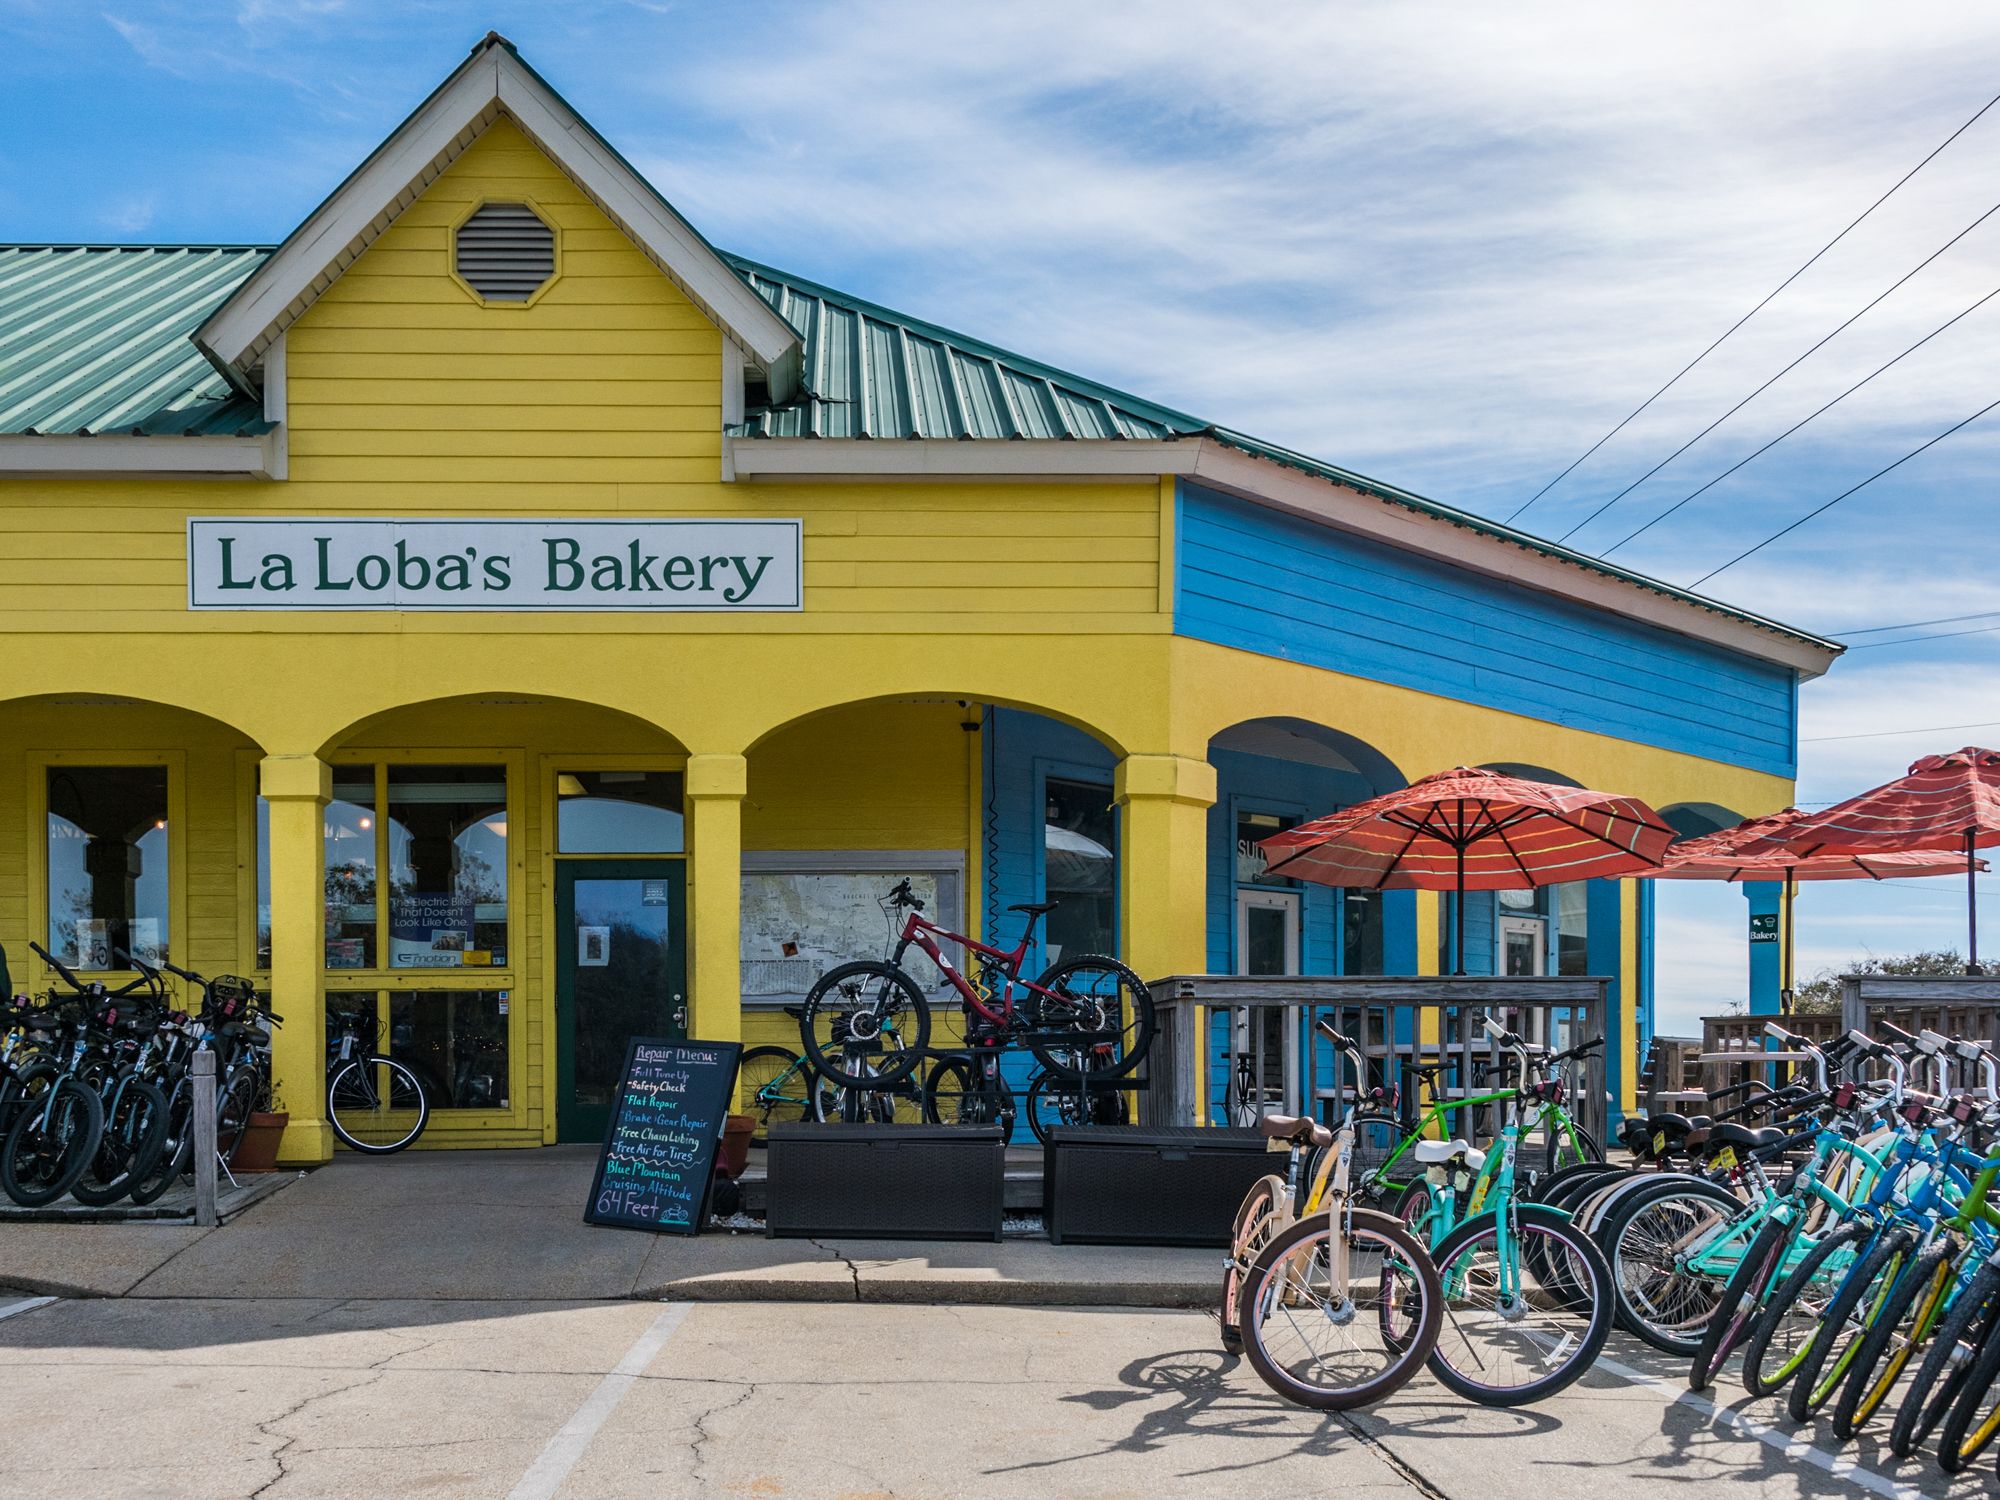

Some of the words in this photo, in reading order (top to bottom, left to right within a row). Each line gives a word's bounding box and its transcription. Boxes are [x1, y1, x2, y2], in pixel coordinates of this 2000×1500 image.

[217, 537, 296, 592] La
[314, 537, 512, 593] Loba's
[543, 538, 774, 603] Bakery
[413, 897, 449, 907] Electric
[451, 897, 472, 907] Bike
[400, 908, 422, 917] That
[424, 908, 463, 917] Doesn't
[395, 918, 420, 927] Look
[422, 918, 442, 927] Like
[1750, 931, 1778, 941] Bakery
[636, 1045, 673, 1064] Repair
[676, 1048, 717, 1062] Menu:
[655, 1068, 676, 1079] Tune
[677, 1070, 690, 1083] Up
[660, 1081, 687, 1093] Check
[649, 1096, 678, 1111] Repair
[680, 1114, 709, 1131] Repair
[641, 1128, 668, 1142] Chain
[669, 1131, 700, 1152] Lubing
[636, 1143, 652, 1156] Air
[669, 1146, 694, 1162] Tires
[606, 1160, 631, 1175] Blue
[632, 1162, 681, 1181] Mountain
[602, 1175, 646, 1198] Cruising
[647, 1180, 693, 1201] Altitude
[597, 1190, 622, 1214] 64
[624, 1191, 660, 1218] Feet
